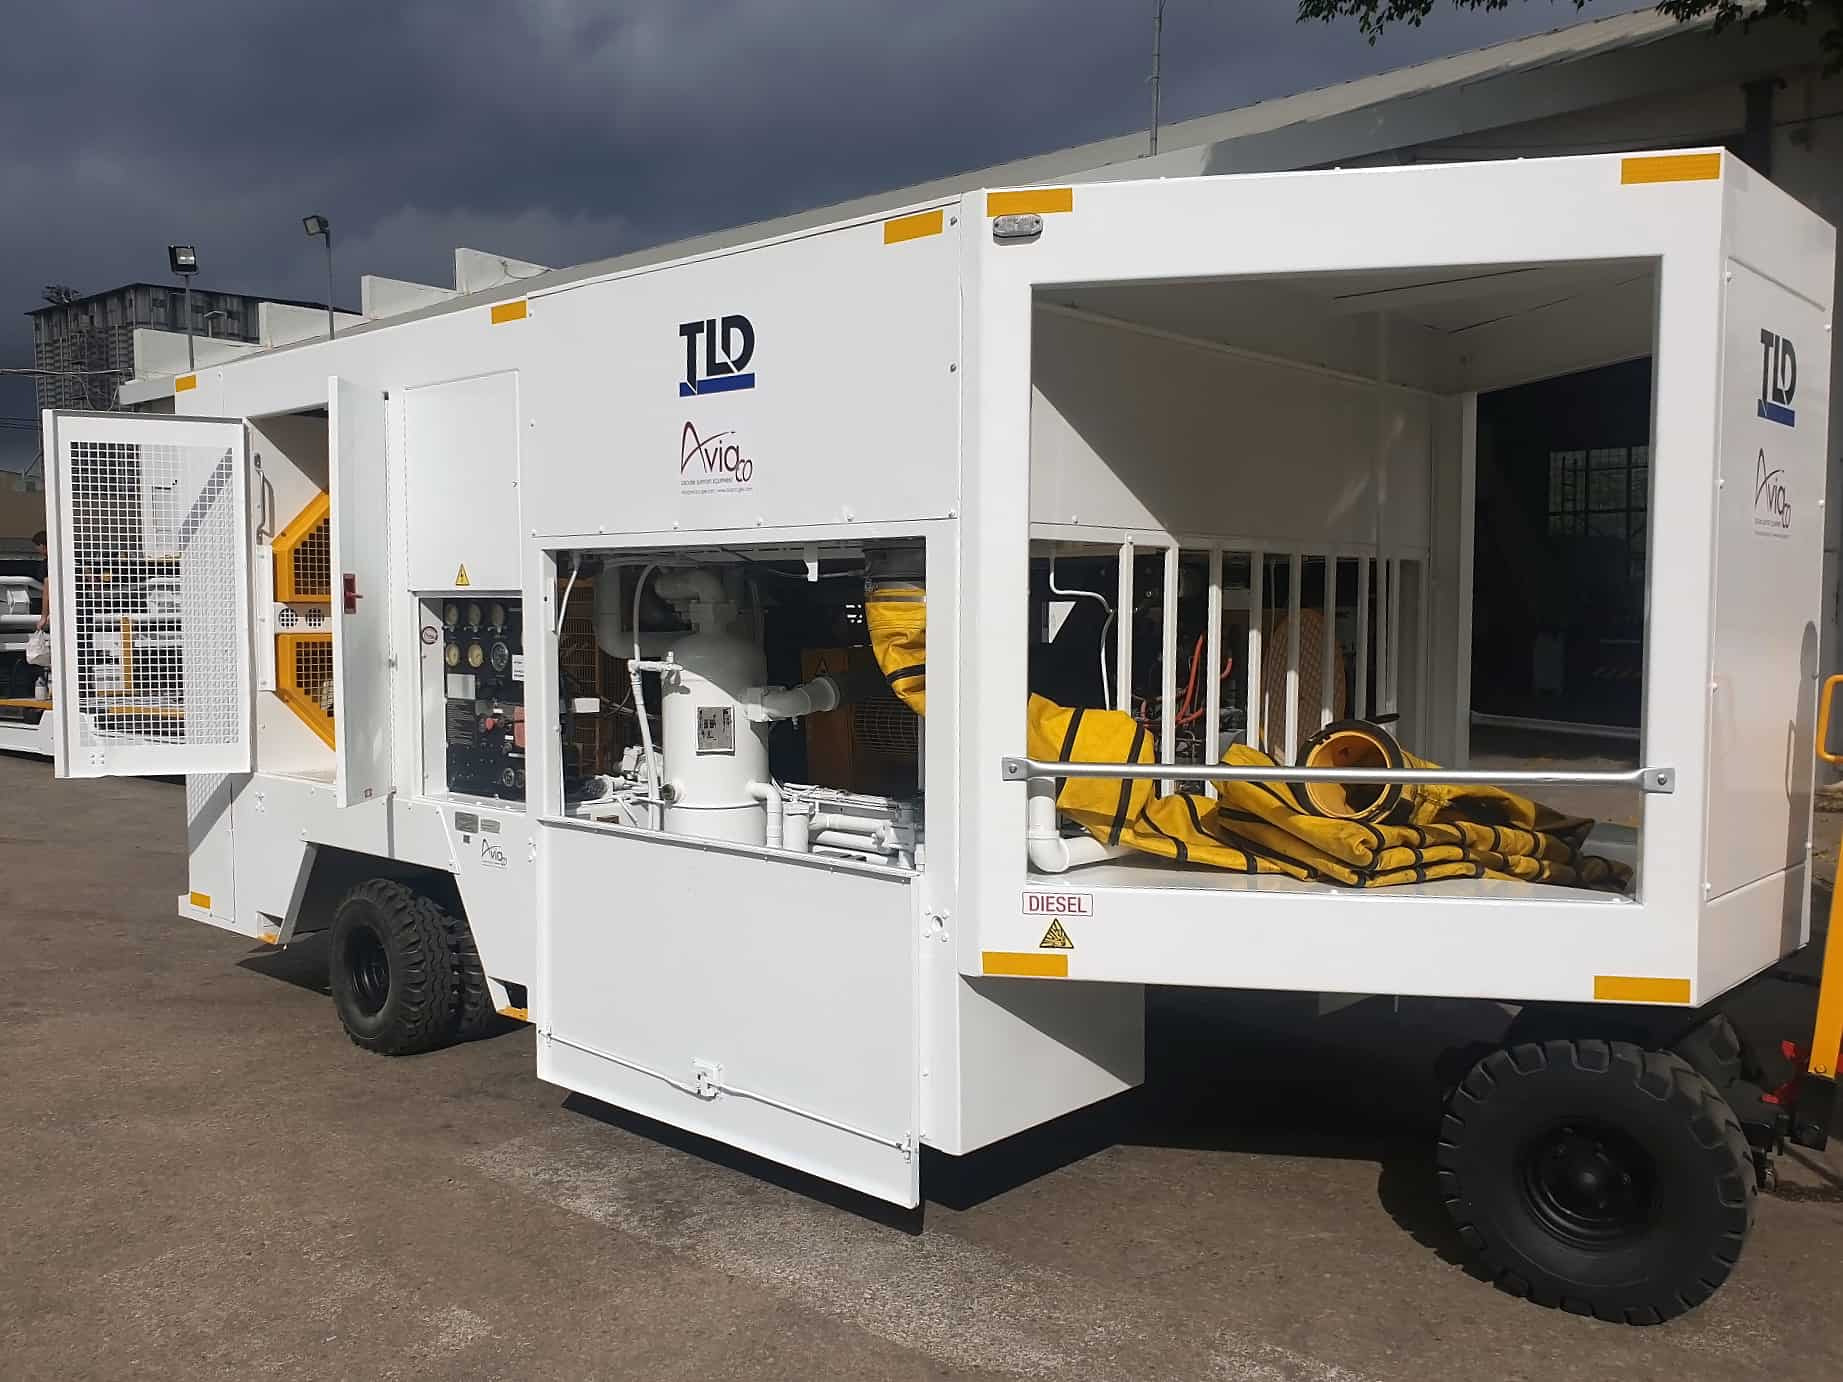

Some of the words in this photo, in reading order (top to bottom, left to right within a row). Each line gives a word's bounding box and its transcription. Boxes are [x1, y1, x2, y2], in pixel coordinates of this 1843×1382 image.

[679, 314, 755, 395] TLD
[1760, 328, 1797, 416] TLD
[681, 421, 753, 482] Aviaco
[1029, 895, 1087, 913] DIESEL
